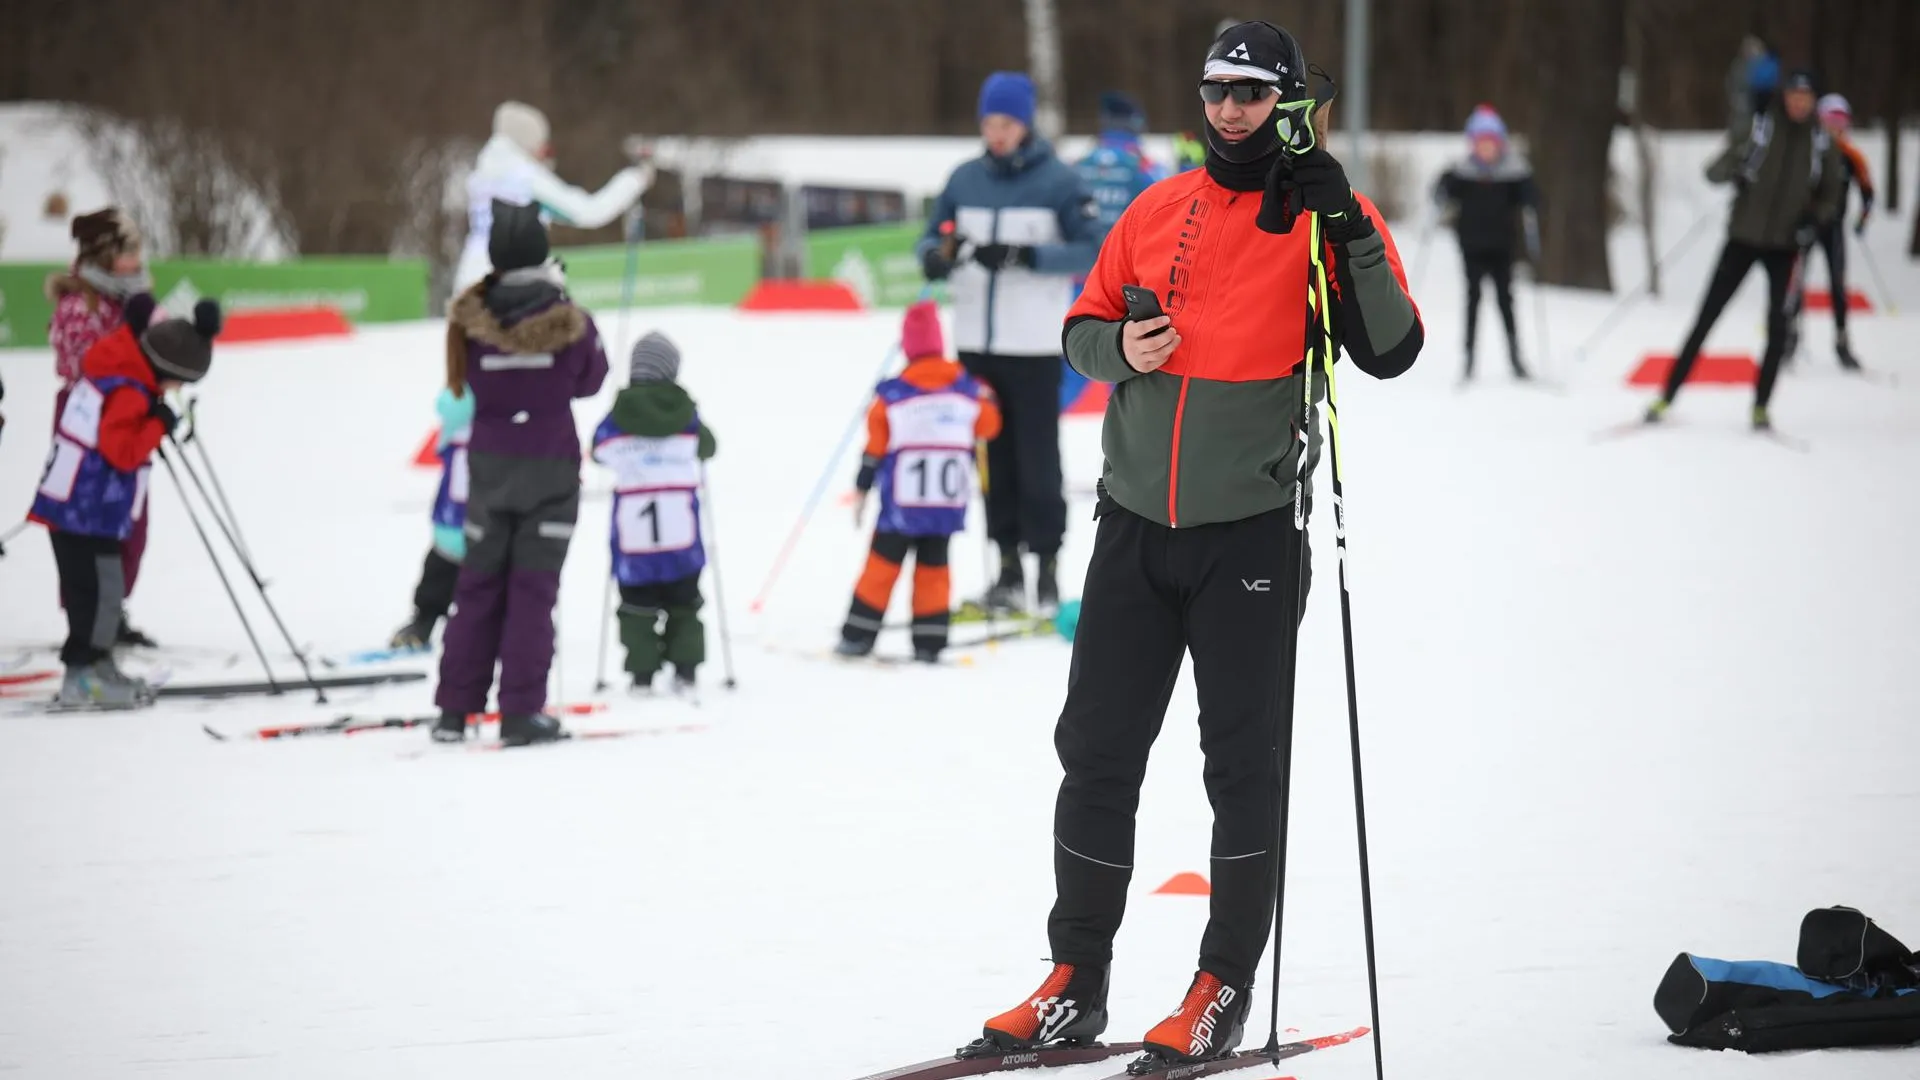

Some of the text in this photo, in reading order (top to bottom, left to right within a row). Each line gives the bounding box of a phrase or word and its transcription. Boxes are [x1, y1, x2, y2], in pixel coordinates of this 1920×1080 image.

[1165, 199, 1210, 322] DSHUS
[907, 458, 967, 499] 10
[638, 500, 660, 543] 1
[1241, 578, 1271, 591] VC
[1189, 985, 1236, 1056] alpina
[1002, 1053, 1039, 1065] ATOMIC
[1167, 1066, 1192, 1080] ATOMIC
